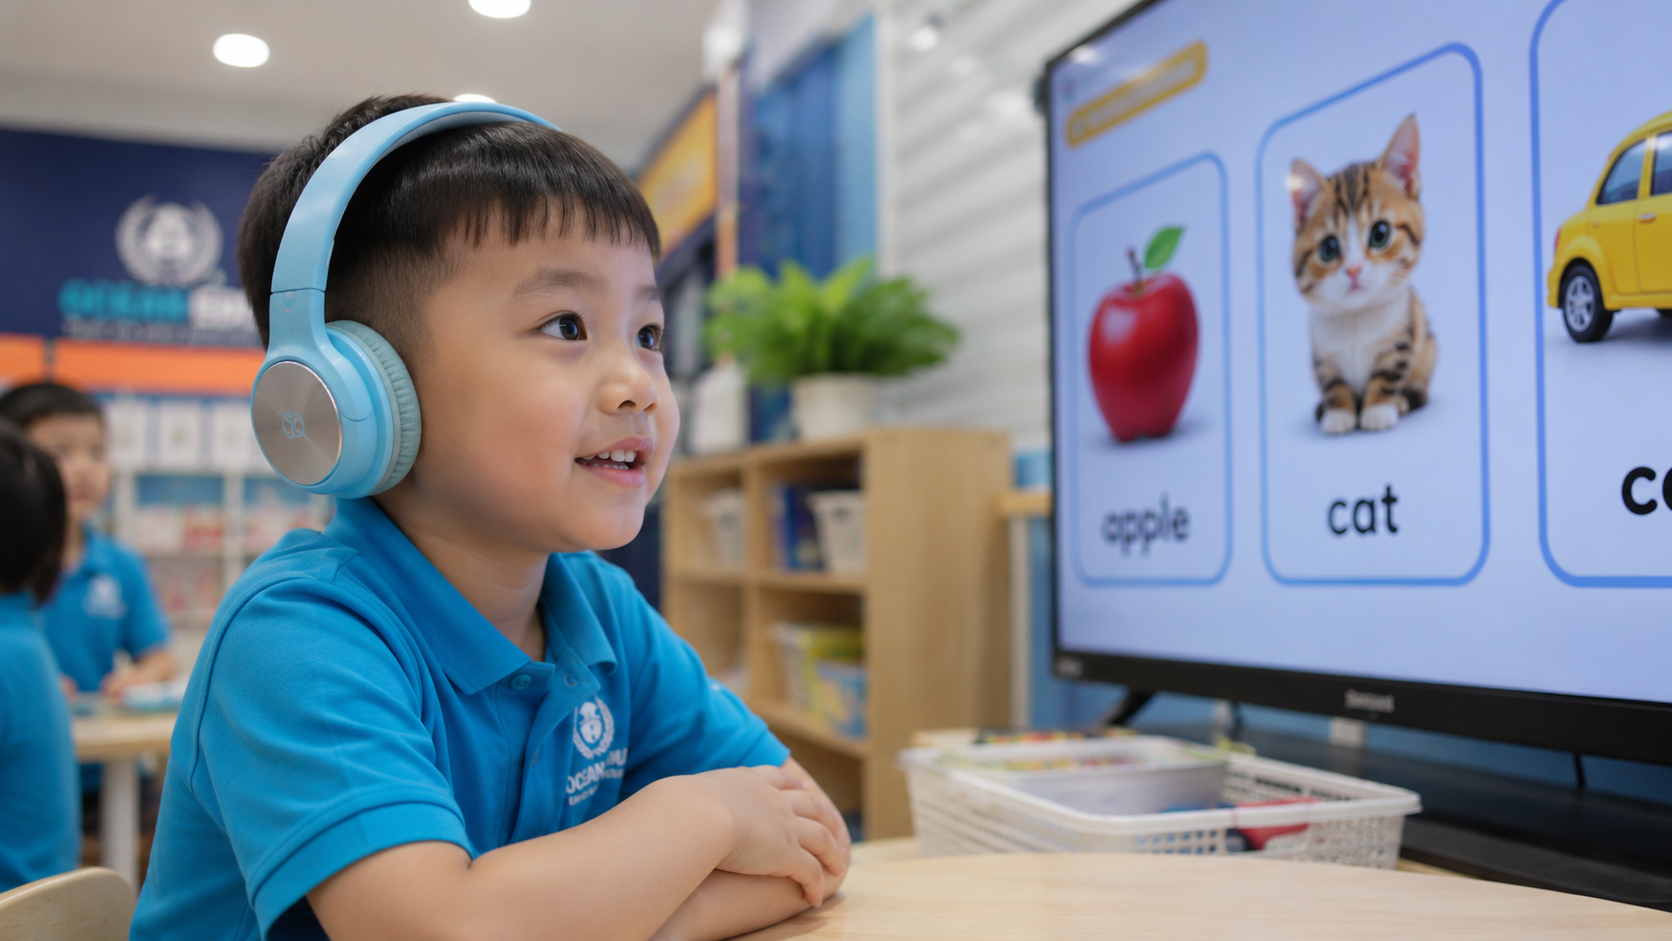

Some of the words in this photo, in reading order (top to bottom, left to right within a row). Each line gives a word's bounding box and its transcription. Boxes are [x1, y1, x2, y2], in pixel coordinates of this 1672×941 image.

[1328, 485, 1398, 536] cat
[1621, 466, 1672, 515] c
[1103, 493, 1189, 555] apple
